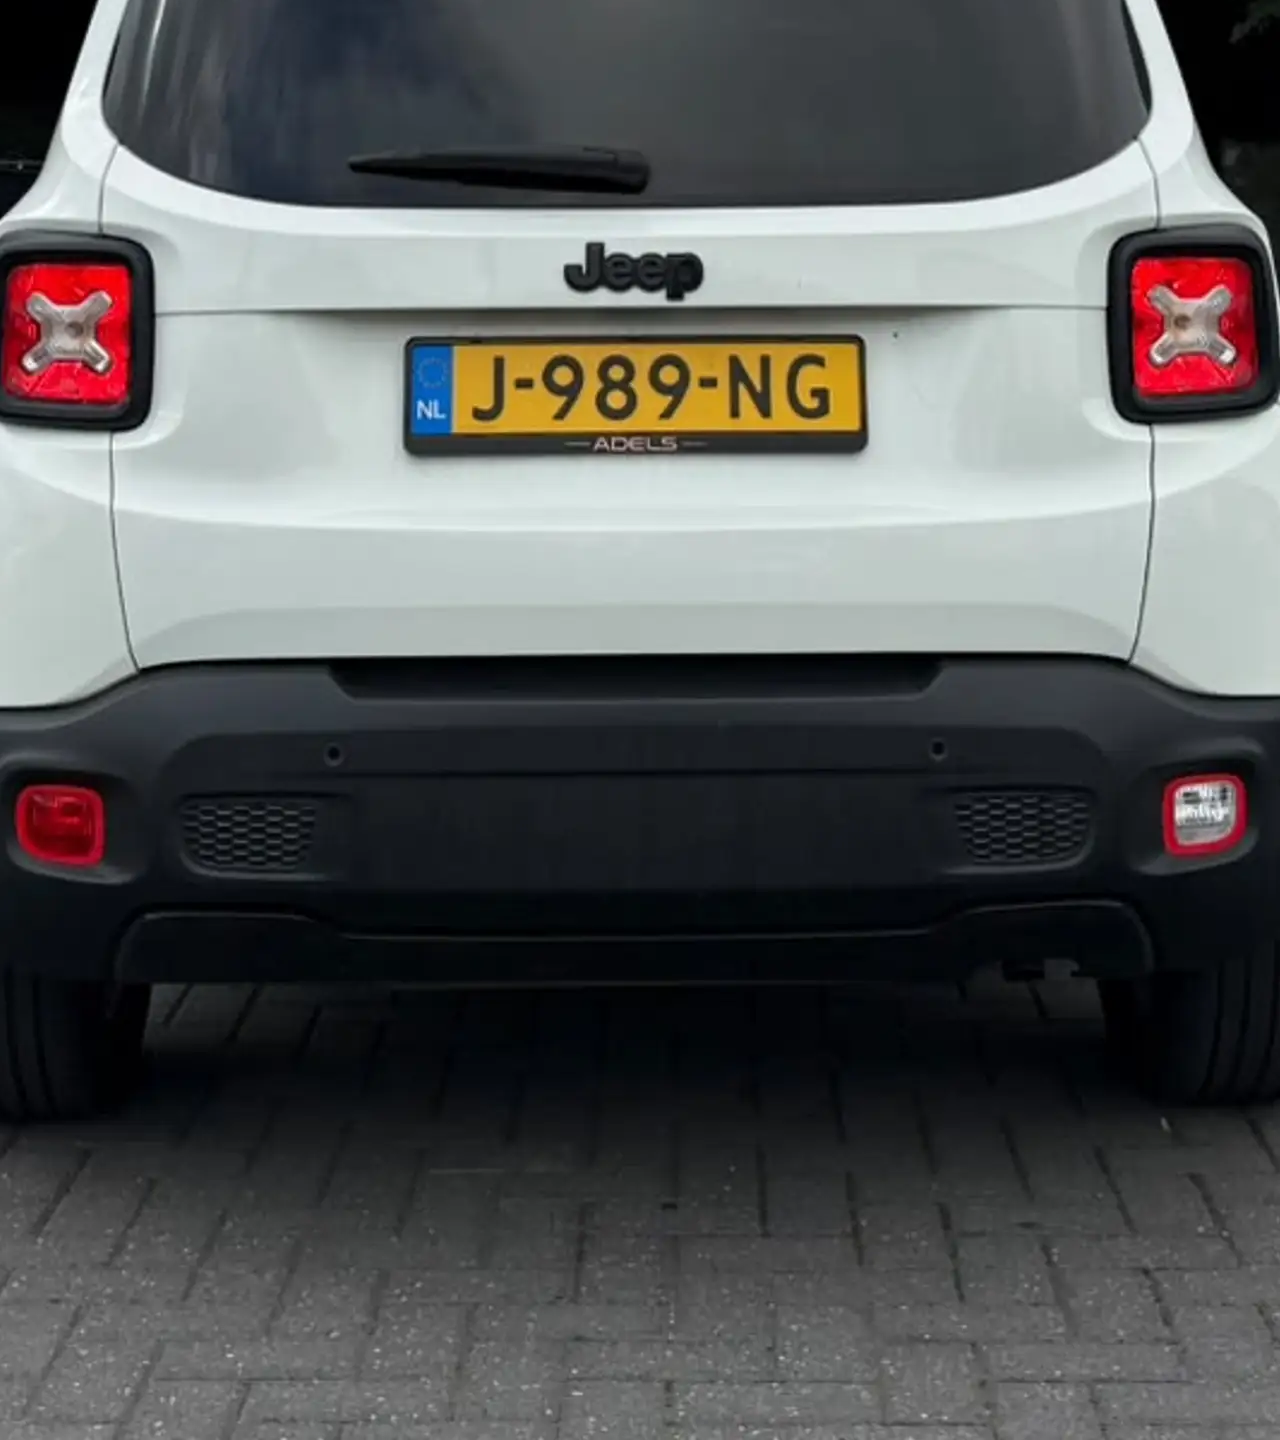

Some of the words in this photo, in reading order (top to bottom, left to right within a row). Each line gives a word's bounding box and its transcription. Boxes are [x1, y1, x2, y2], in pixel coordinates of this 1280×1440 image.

[564, 242, 704, 301] Jeep
[472, 355, 832, 421] J-989-NG
[417, 402, 446, 420] NL
[594, 437, 678, 452] ADELS
